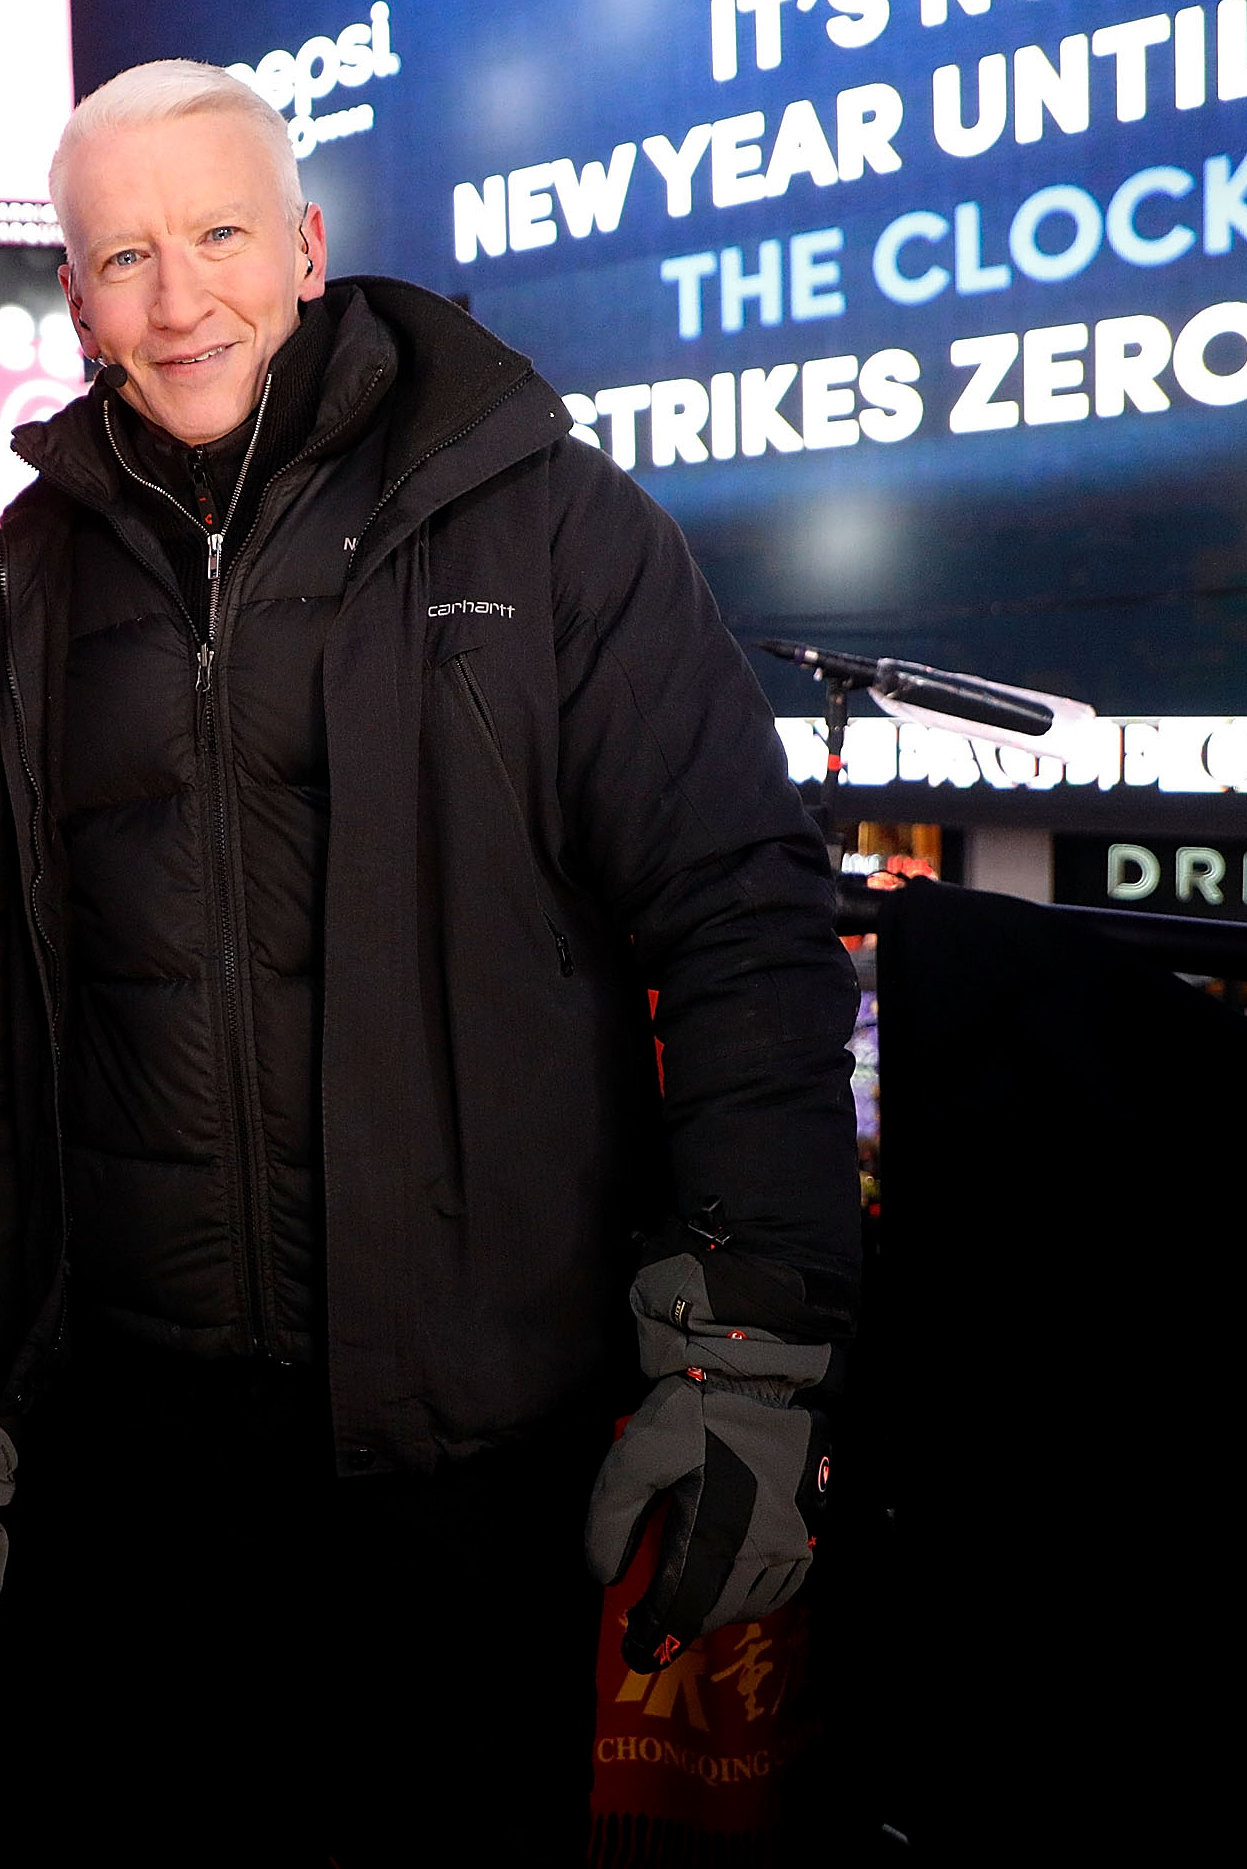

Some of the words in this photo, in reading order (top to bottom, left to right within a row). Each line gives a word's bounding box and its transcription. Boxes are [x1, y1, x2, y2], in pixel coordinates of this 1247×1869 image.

[710, 0, 891, 82] ITS
[453, 143, 636, 263] NEW
[643, 82, 903, 218] YEAR
[660, 227, 847, 341] THE
[872, 149, 1247, 305] CLOCK
[560, 348, 924, 472] STRIKES
[949, 301, 1247, 434] ZERO
[427, 600, 516, 619] carhartt
[1107, 843, 1247, 905] DR
[596, 1736, 770, 1787] CHONGQING
